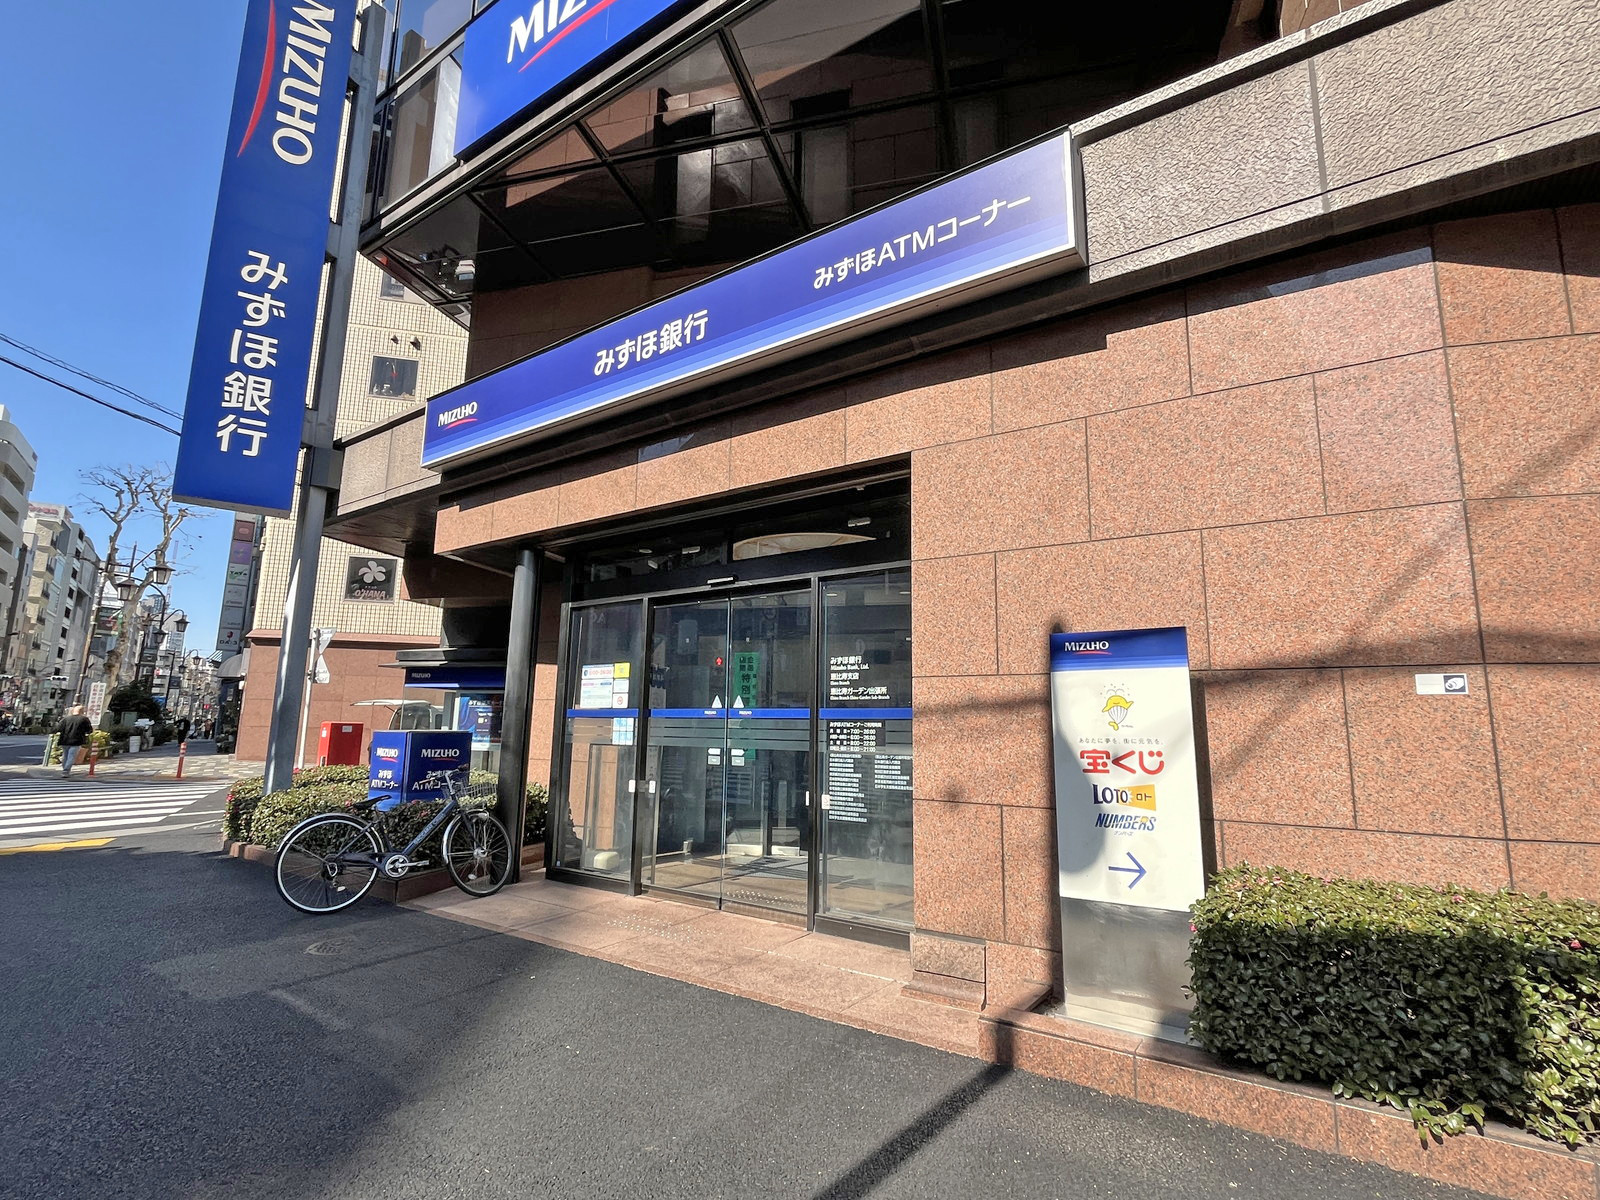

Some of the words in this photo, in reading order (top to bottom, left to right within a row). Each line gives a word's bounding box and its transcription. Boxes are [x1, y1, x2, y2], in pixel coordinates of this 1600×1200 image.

[272, 0, 336, 165] MIZUHO
[813, 196, 1031, 289] みずほATMコーナー
[215, 250, 288, 457] みずほ銀行
[594, 309, 709, 376] みずほ銀行
[437, 401, 478, 427] MIZUHO
[1064, 640, 1110, 652] MIZUHO
[376, 747, 398, 758] MIZUHO
[421, 748, 460, 758] MIZUHO
[1079, 748, 1165, 776] 宝くじ
[371, 779, 399, 790] ATMコーナー
[1092, 784, 1128, 805] LOTO
[1095, 813, 1157, 832] NUMBERS
